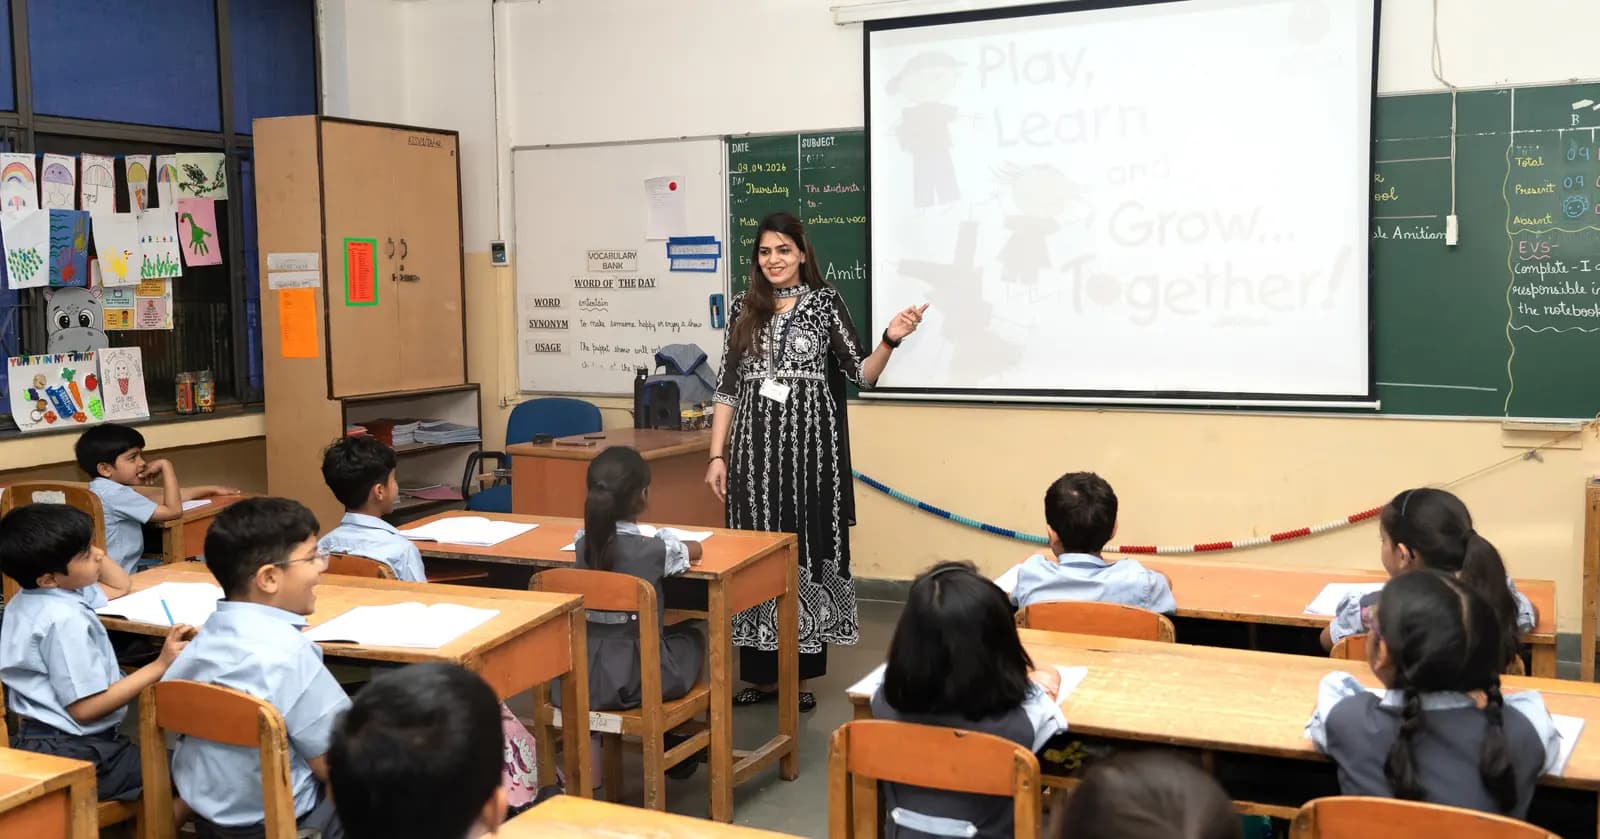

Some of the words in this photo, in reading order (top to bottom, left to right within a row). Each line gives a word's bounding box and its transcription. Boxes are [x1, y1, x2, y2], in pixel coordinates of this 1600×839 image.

[976, 41, 1095, 90] Play,
[993, 102, 1151, 149] Learn
[1571, 114, 1580, 126] B
[731, 142, 750, 154] DATE
[801, 136, 836, 148] SUBJECT
[1514, 156, 1545, 168] Total
[1106, 154, 1171, 186] and
[746, 182, 789, 198] Thursday
[1374, 186, 1398, 201] ool
[588, 251, 638, 261] VOCABULARY
[602, 262, 624, 270] BANK
[574, 279, 601, 289] WORD
[602, 279, 614, 289] OF
[618, 278, 636, 289] THE
[638, 278, 656, 288] DAY
[534, 297, 561, 308] WORD
[1518, 301, 1540, 316] the
[529, 319, 569, 330] SYNONYM
[535, 343, 562, 353] USAGE
[43, 355, 53, 365] IN
[54, 354, 65, 364] MY
